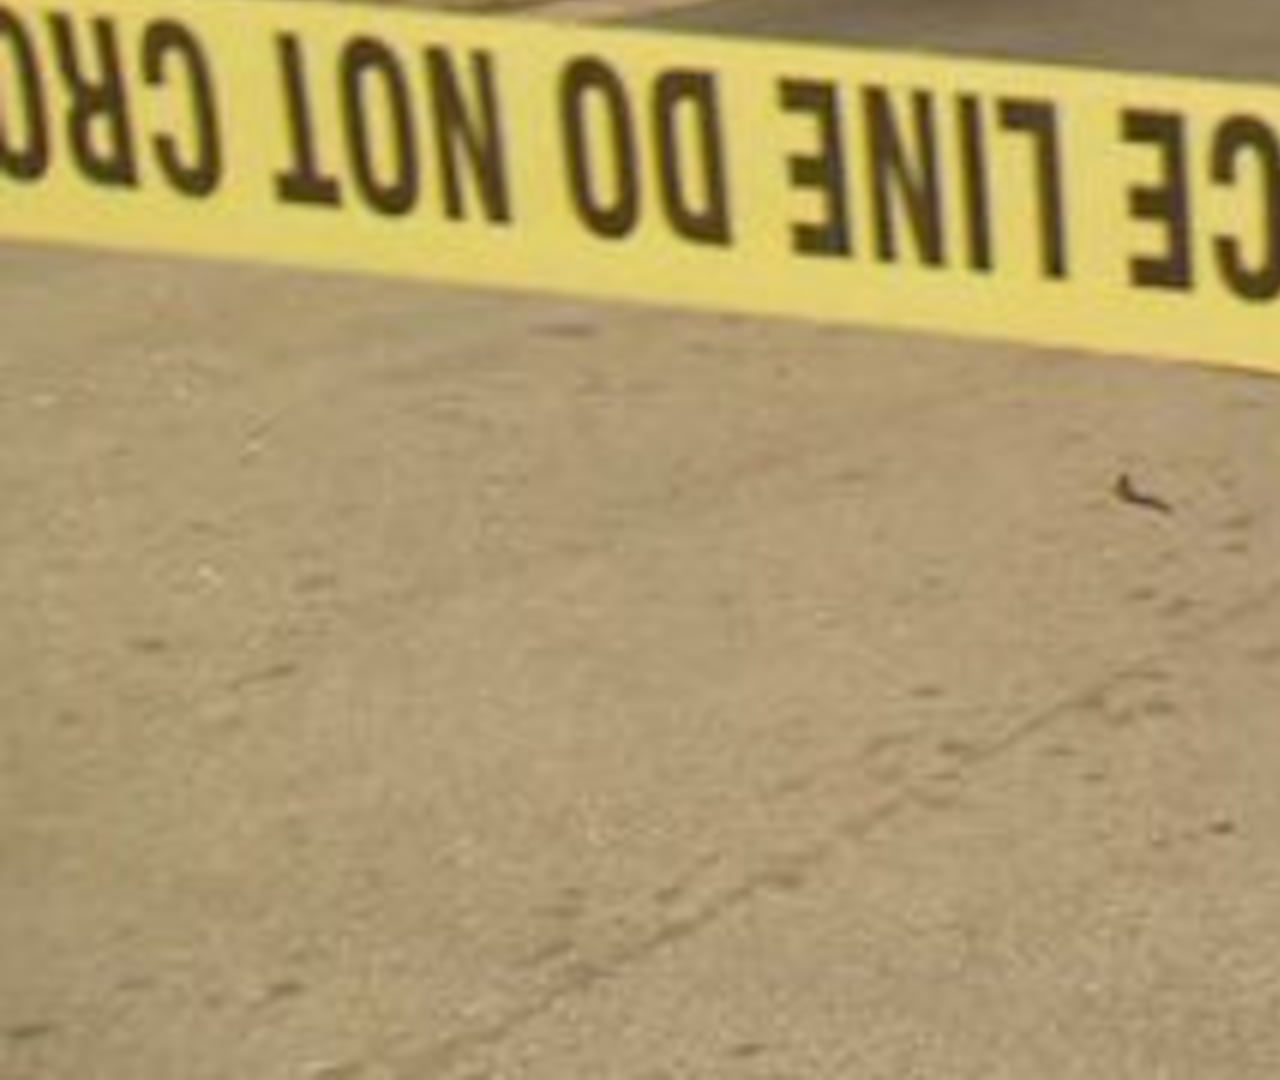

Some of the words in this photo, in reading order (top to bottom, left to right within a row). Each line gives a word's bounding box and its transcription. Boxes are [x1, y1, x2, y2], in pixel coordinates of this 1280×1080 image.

[274, 32, 512, 226] NOT
[558, 54, 733, 248] DO
[777, 77, 1069, 281] LINE
